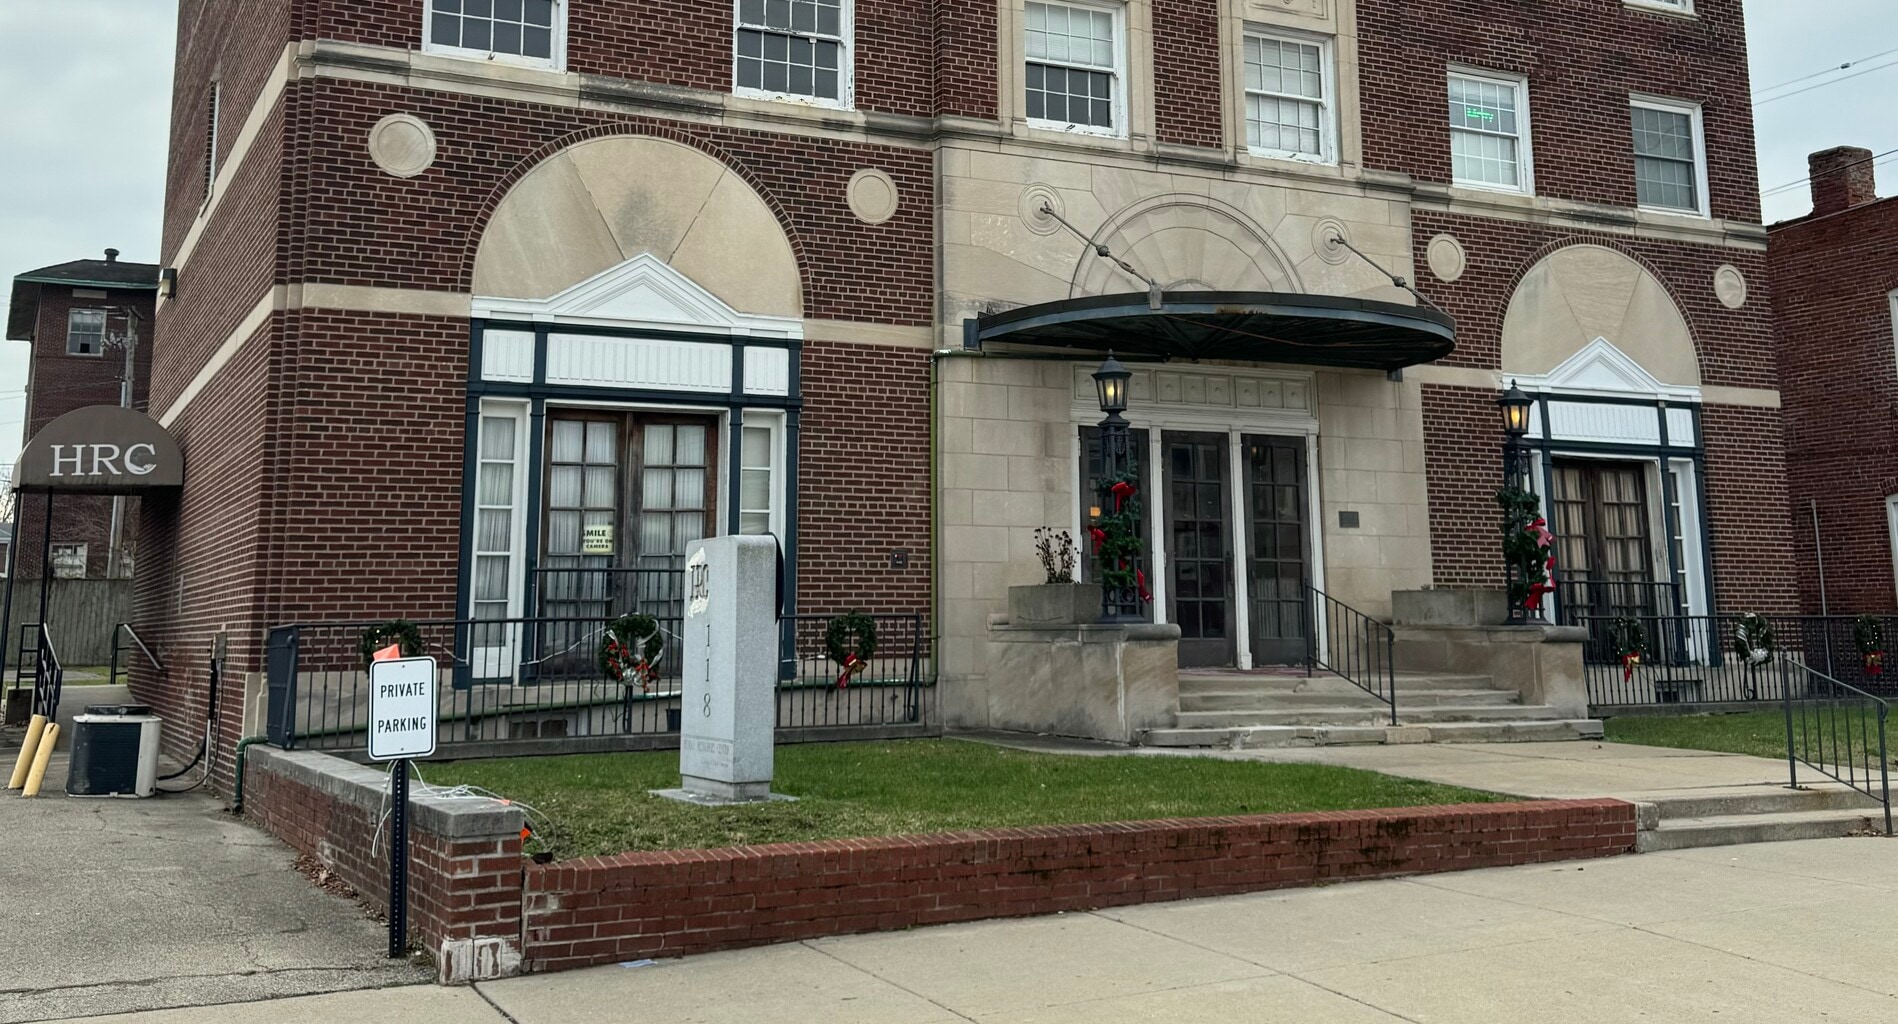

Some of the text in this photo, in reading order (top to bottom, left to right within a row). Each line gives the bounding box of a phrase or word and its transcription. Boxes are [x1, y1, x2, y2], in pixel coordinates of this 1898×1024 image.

[49, 443, 157, 476] HRC
[380, 682, 425, 698] PRIVATE
[378, 716, 426, 733] PARKING
